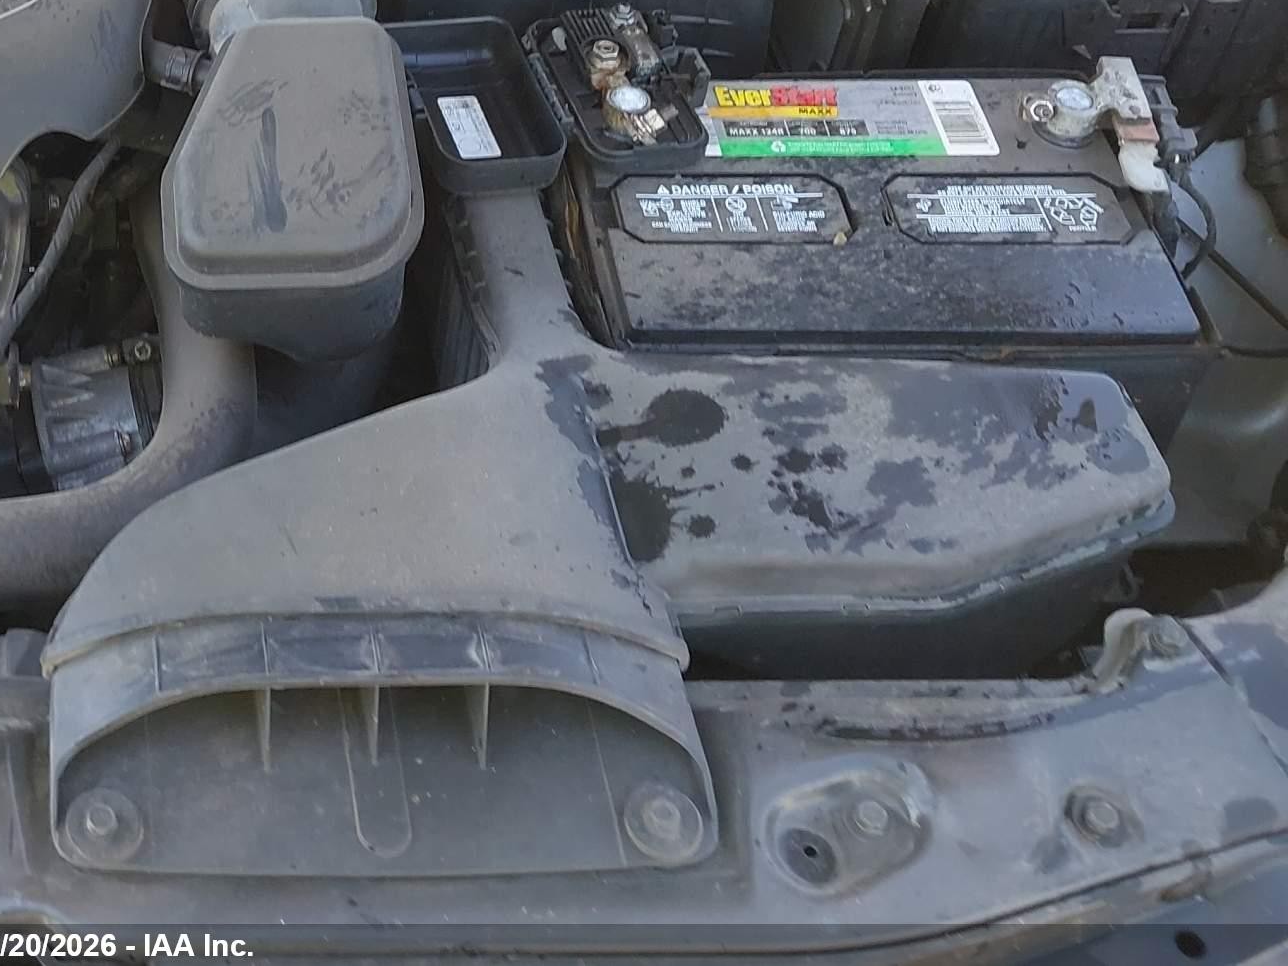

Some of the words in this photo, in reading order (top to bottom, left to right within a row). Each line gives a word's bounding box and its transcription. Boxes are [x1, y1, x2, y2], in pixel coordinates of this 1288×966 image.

[798, 107, 833, 115] MAXX
[729, 127, 759, 136] MAXX
[671, 184, 729, 195] DANGER
[742, 184, 795, 195] POISON
